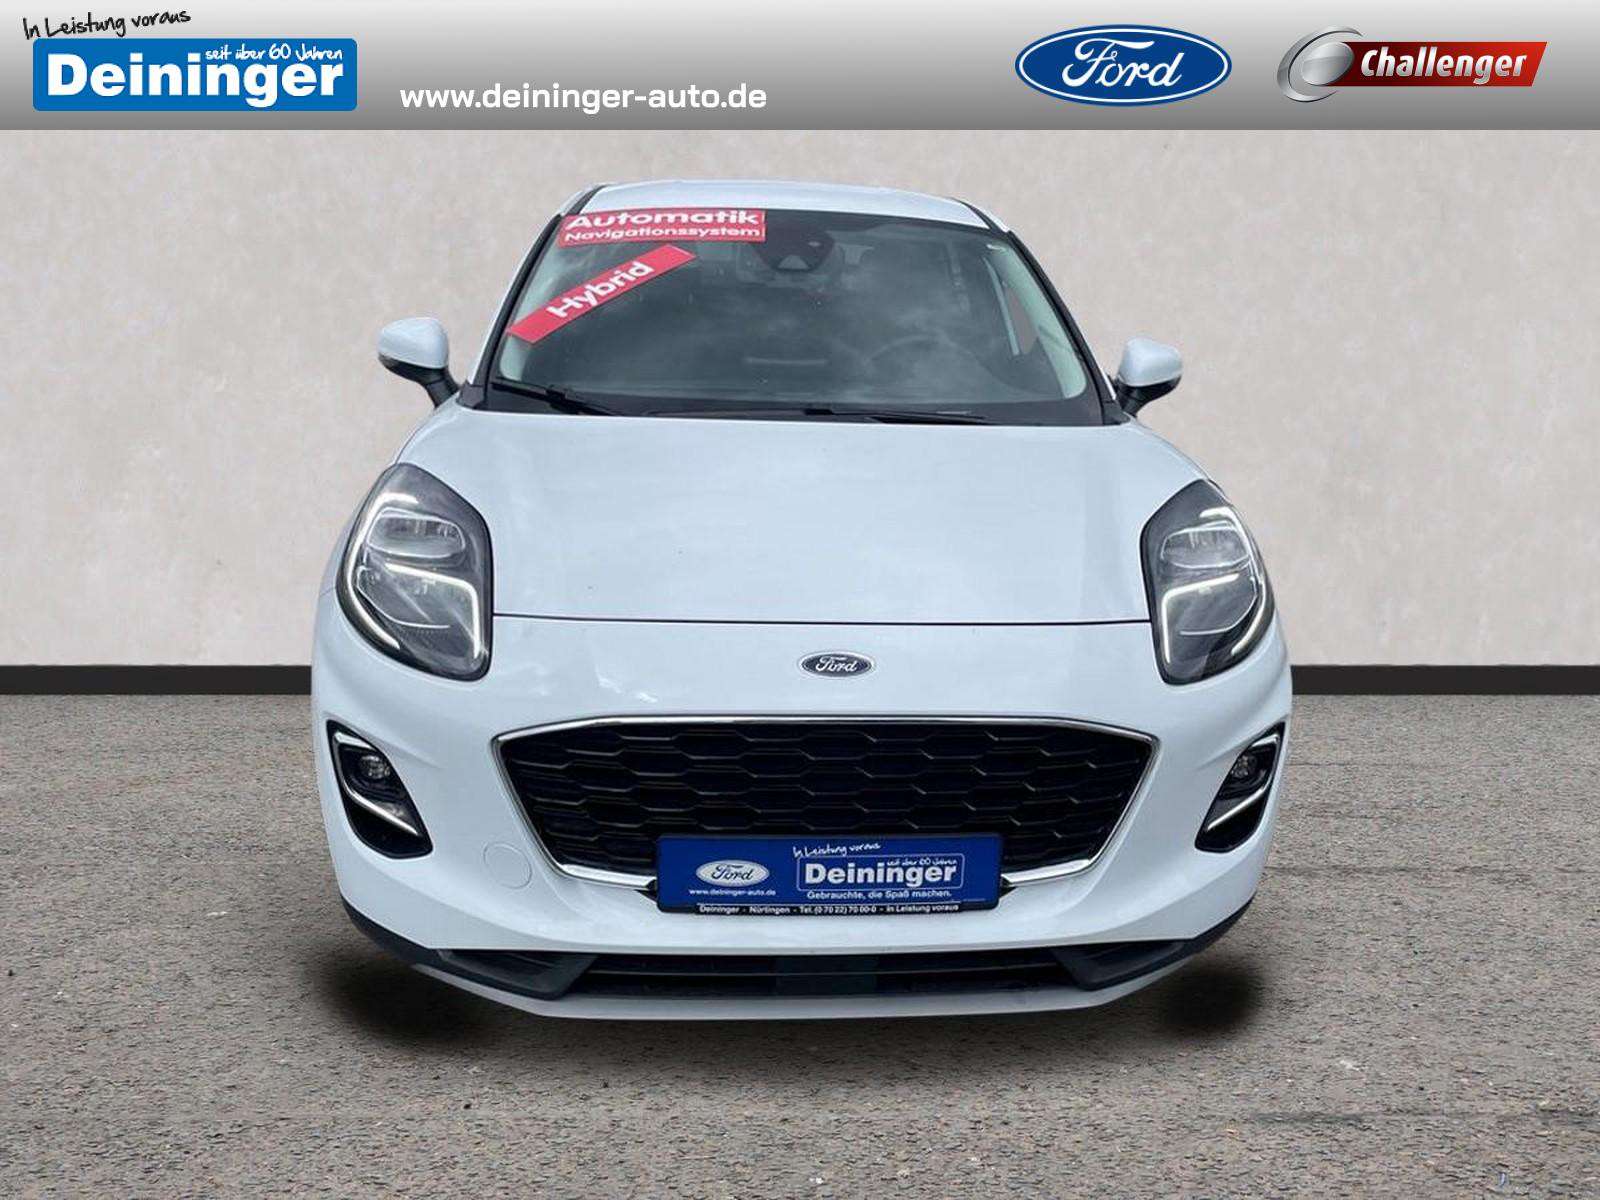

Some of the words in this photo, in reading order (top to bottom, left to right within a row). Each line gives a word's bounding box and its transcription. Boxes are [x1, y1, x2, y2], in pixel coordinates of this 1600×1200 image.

[564, 210, 759, 231] Automatik
[564, 226, 761, 242] Navigationssystem
[546, 260, 654, 318] Hybrid
[815, 656, 857, 672] Ford
[711, 864, 754, 881] Ford
[805, 862, 957, 887] Deininger
